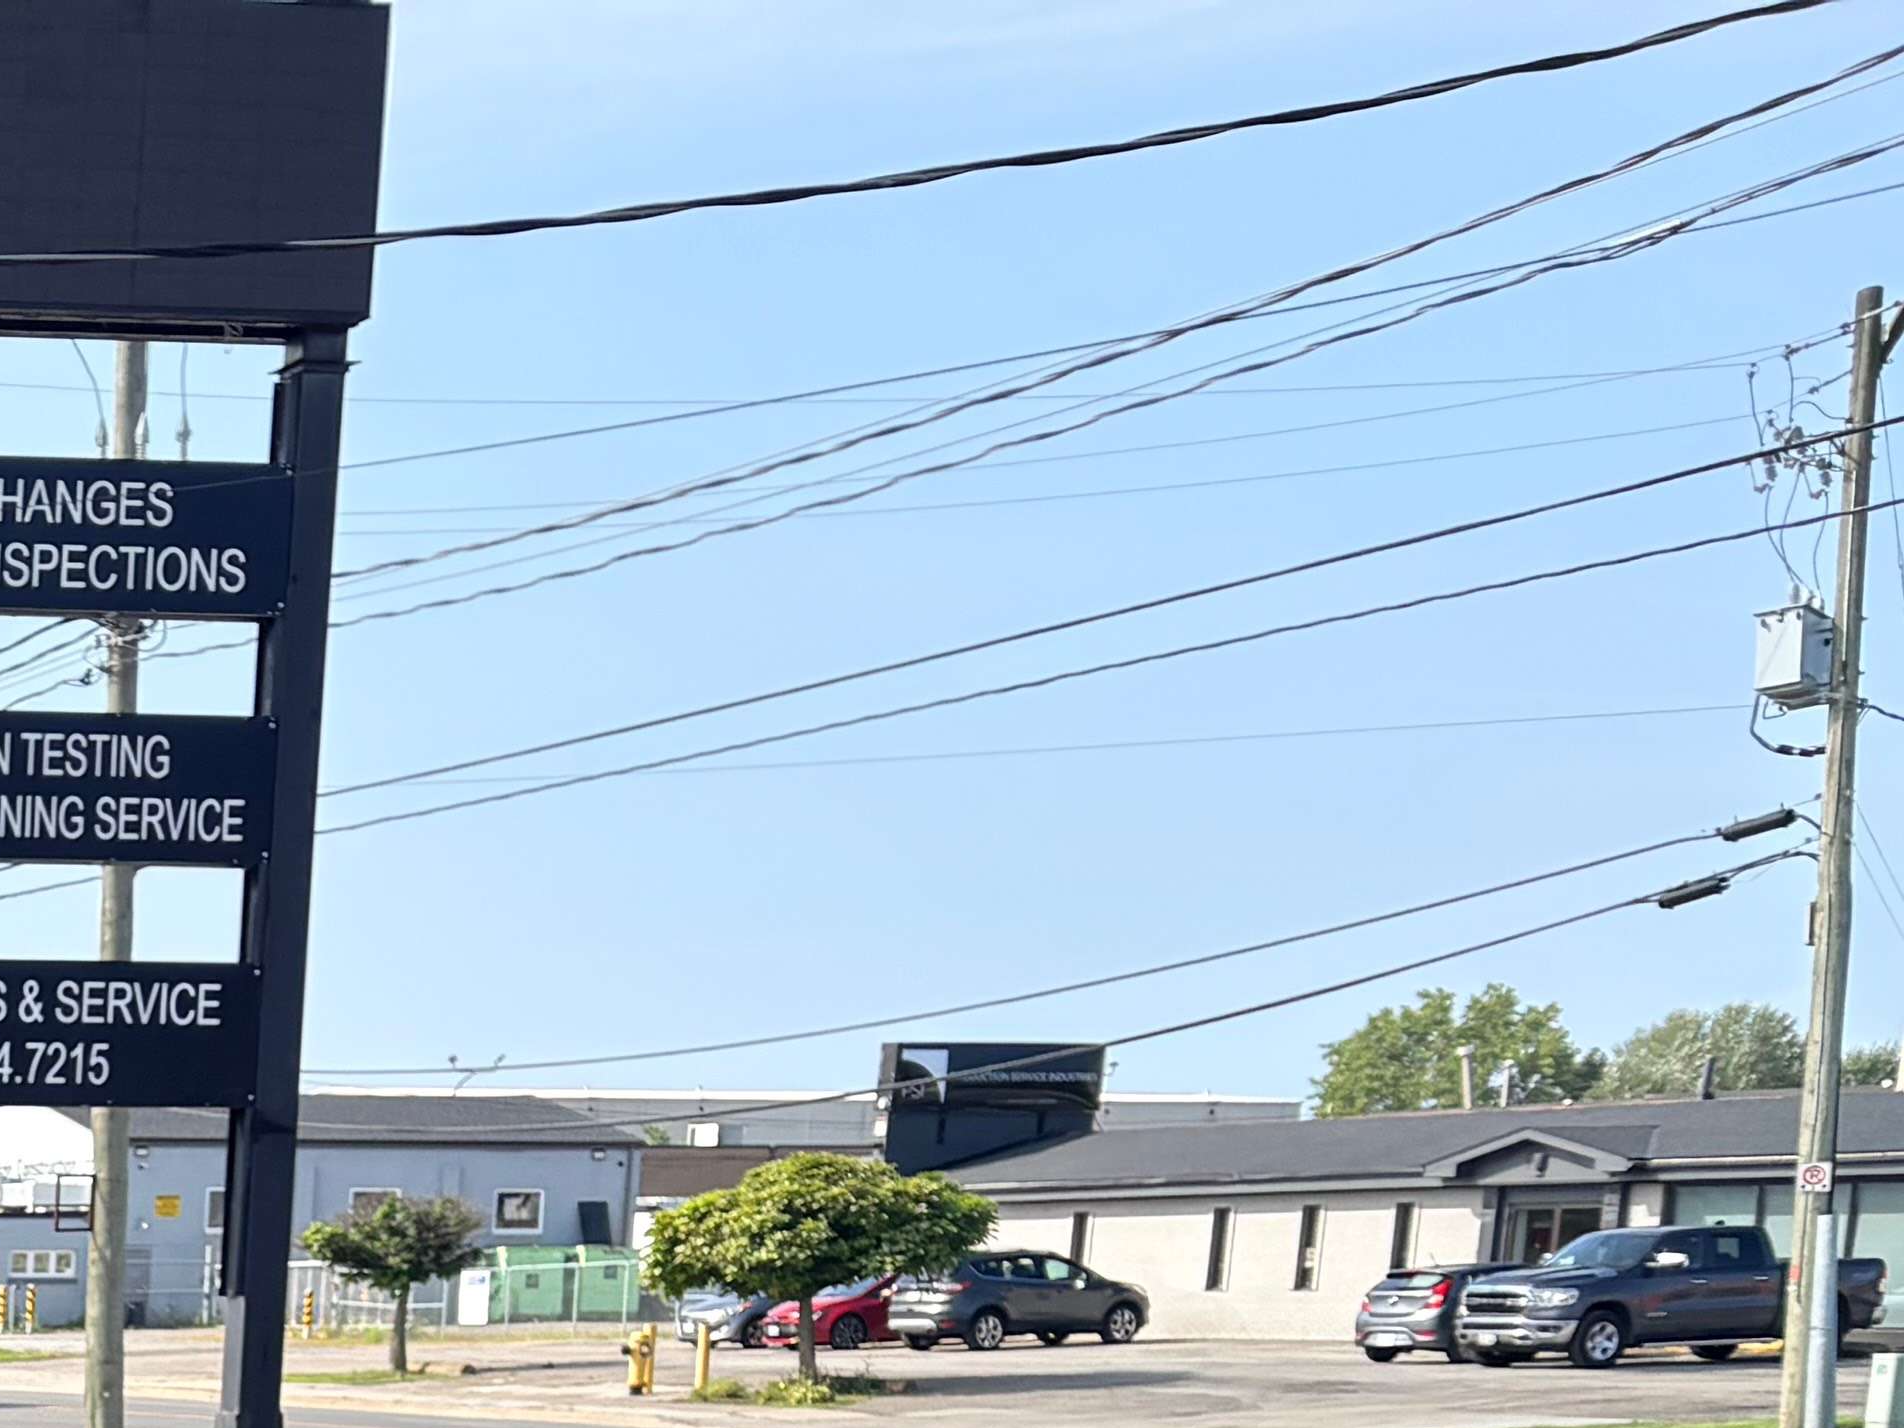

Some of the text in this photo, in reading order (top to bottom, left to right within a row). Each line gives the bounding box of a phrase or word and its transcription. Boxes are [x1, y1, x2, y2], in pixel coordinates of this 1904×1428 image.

[20, 732, 170, 779] TESTING
[94, 795, 246, 842] SERVICE
[18, 979, 44, 1023] &
[54, 980, 222, 1026] SERVICE
